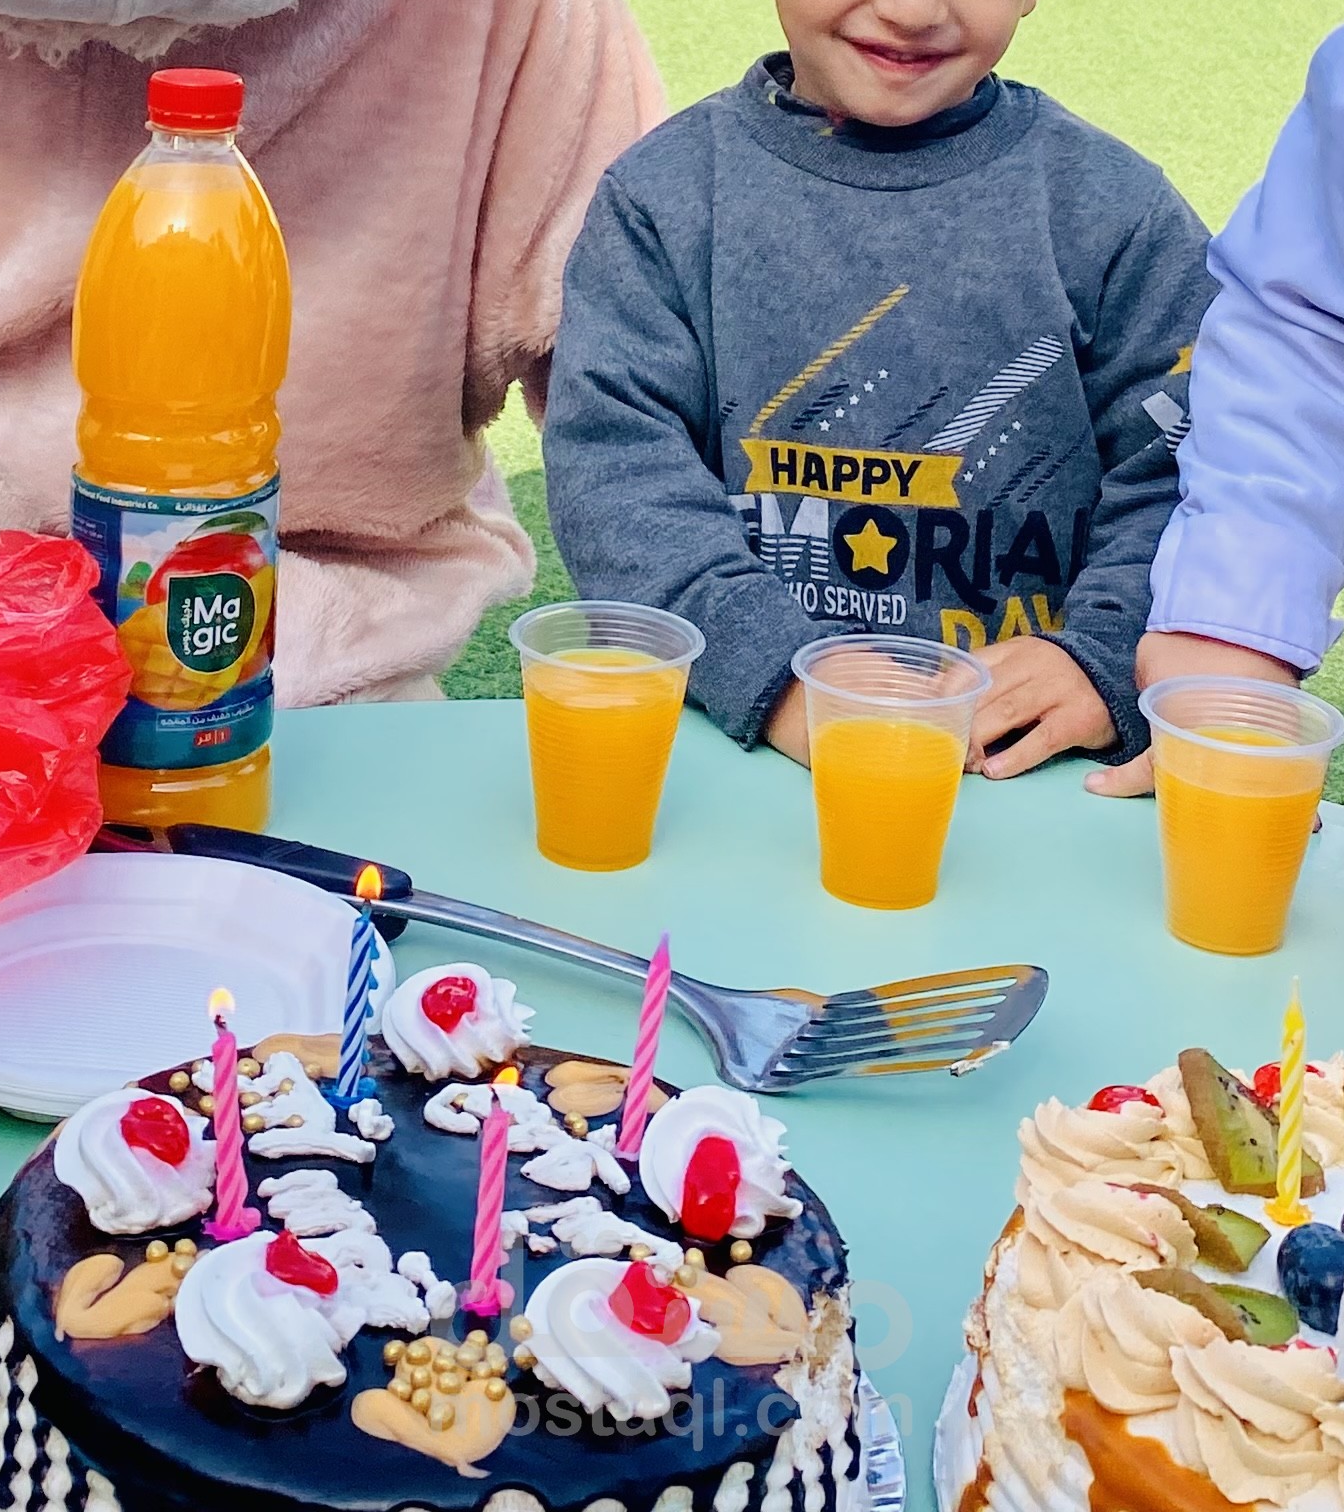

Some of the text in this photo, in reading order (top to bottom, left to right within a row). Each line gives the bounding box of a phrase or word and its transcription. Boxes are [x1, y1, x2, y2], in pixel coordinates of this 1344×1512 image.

[769, 446, 922, 497] HAPPY
[787, 580, 906, 626] HO SERVED
